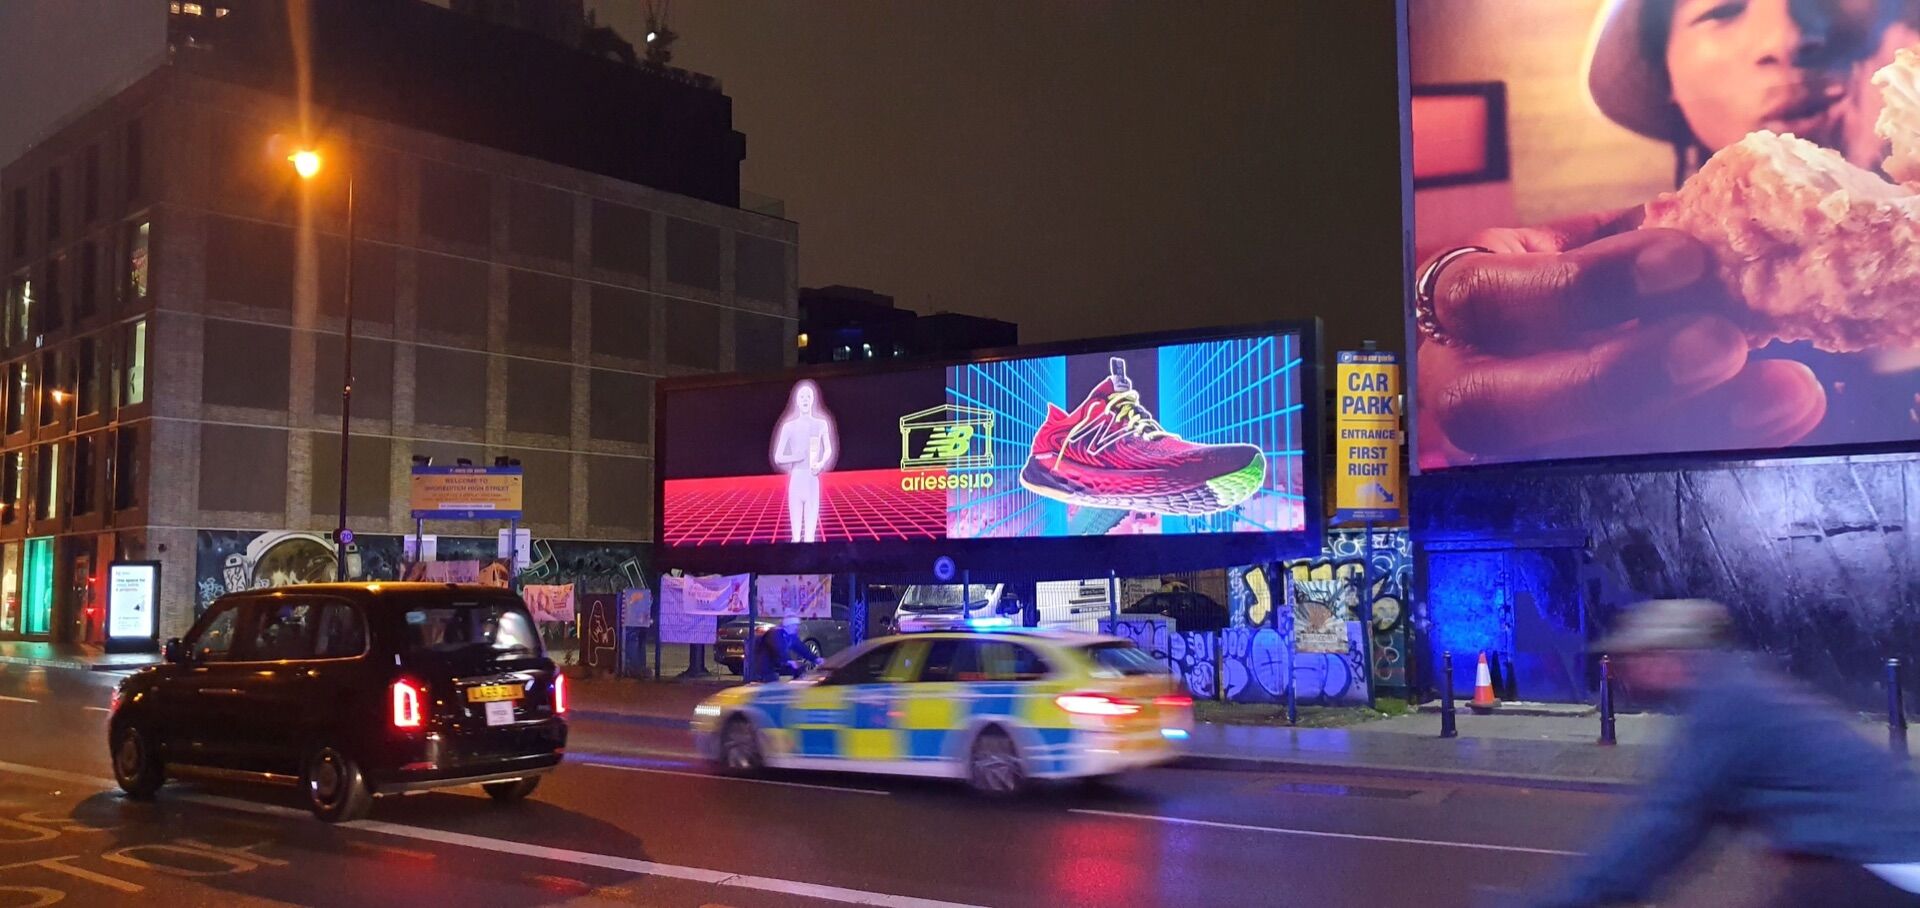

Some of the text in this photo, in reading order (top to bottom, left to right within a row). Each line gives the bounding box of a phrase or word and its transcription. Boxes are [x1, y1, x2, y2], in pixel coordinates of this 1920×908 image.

[1348, 372, 1388, 392] CAR
[1343, 396, 1393, 414] PARK
[1341, 429, 1396, 439] ENTRANCE
[1349, 446, 1387, 459] FIRST
[1348, 463, 1388, 476] RIGHT
